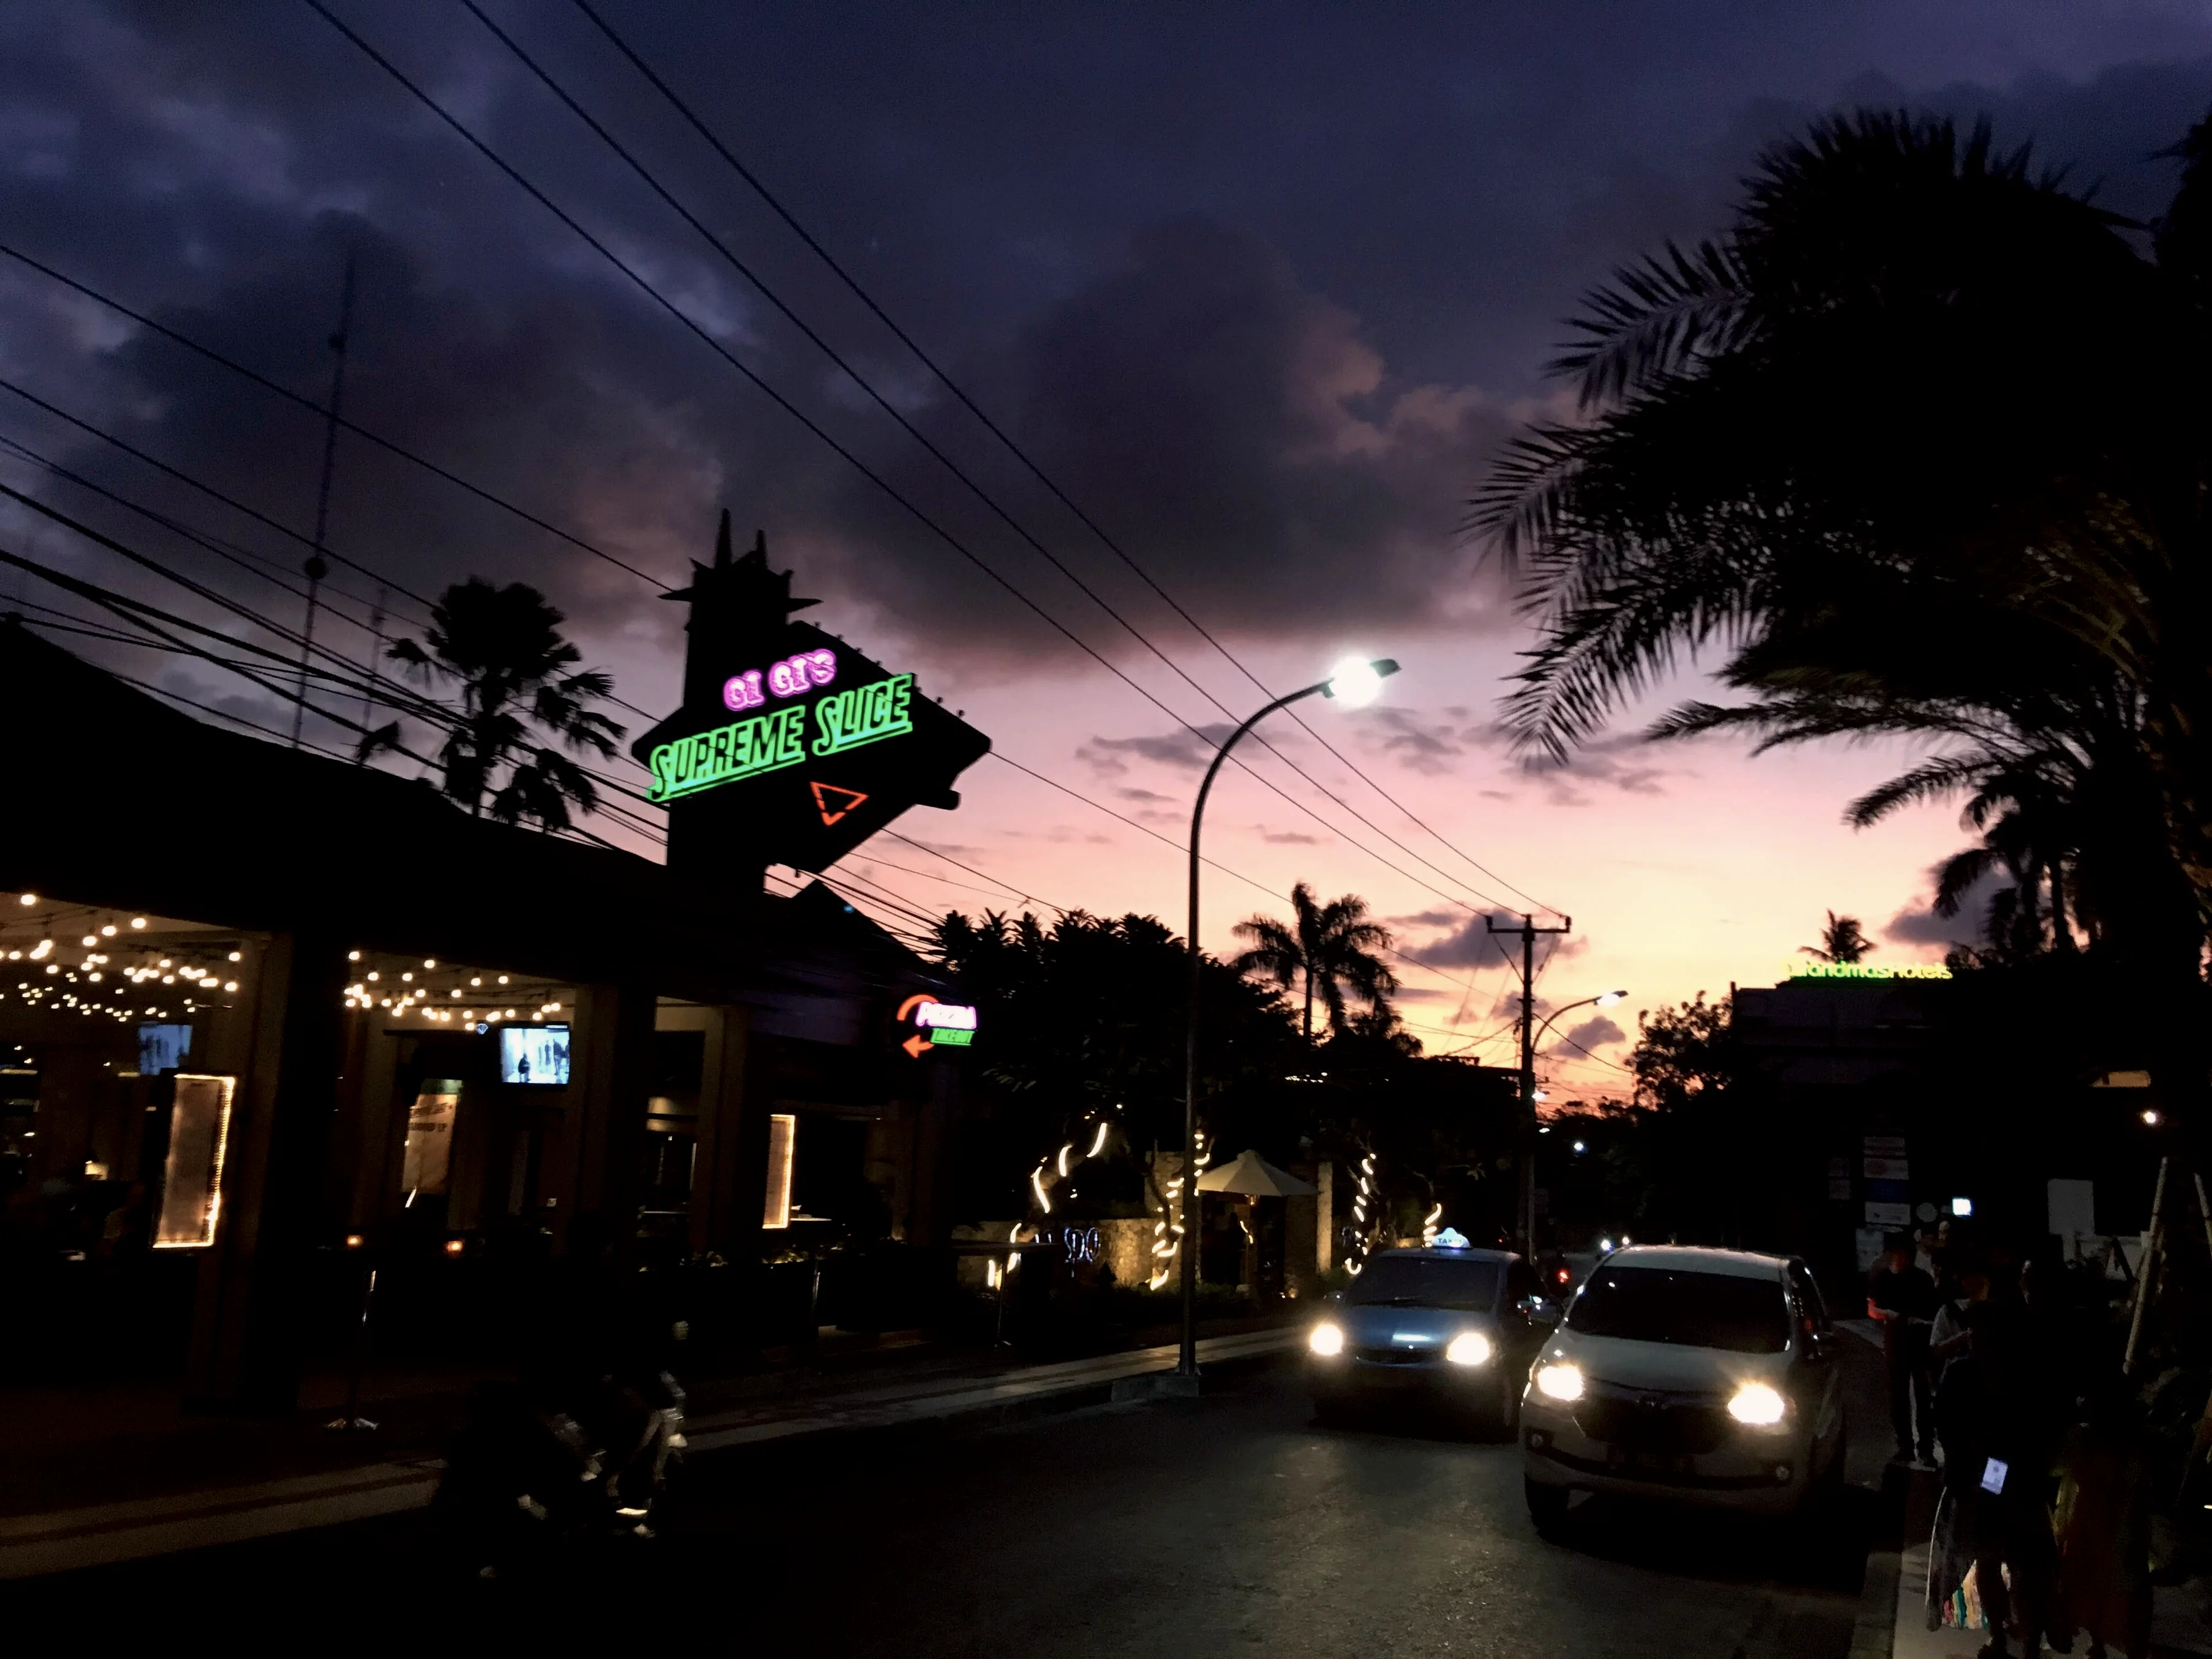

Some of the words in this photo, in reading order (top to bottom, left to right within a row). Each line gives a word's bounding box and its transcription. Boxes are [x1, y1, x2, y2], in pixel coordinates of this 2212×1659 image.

[723, 670, 766, 712] GI
[646, 705, 806, 802] SUPREME
[812, 673, 913, 756] SLICE
